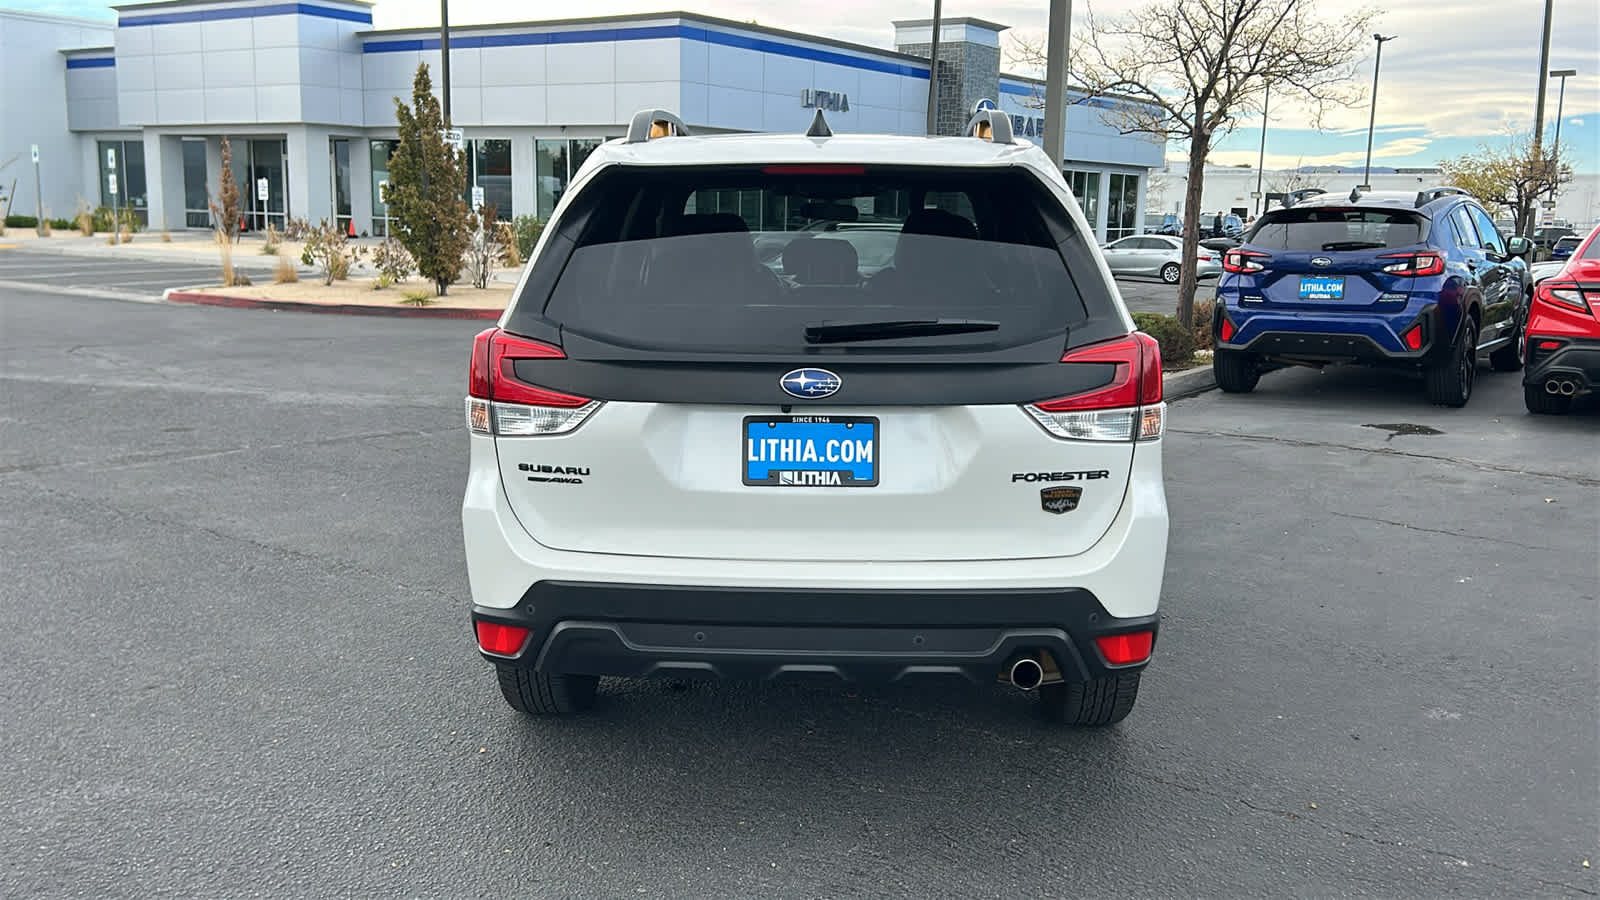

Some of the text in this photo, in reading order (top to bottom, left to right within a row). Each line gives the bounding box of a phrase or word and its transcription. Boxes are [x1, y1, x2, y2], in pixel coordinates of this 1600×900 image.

[801, 88, 850, 112] LITHIA
[1300, 283, 1343, 292] LITHIA.COM
[748, 438, 873, 463] LITHIA.COM
[518, 463, 590, 476] SUBARU
[1012, 470, 1110, 483] FORESTER
[793, 470, 841, 485] LITHIA
